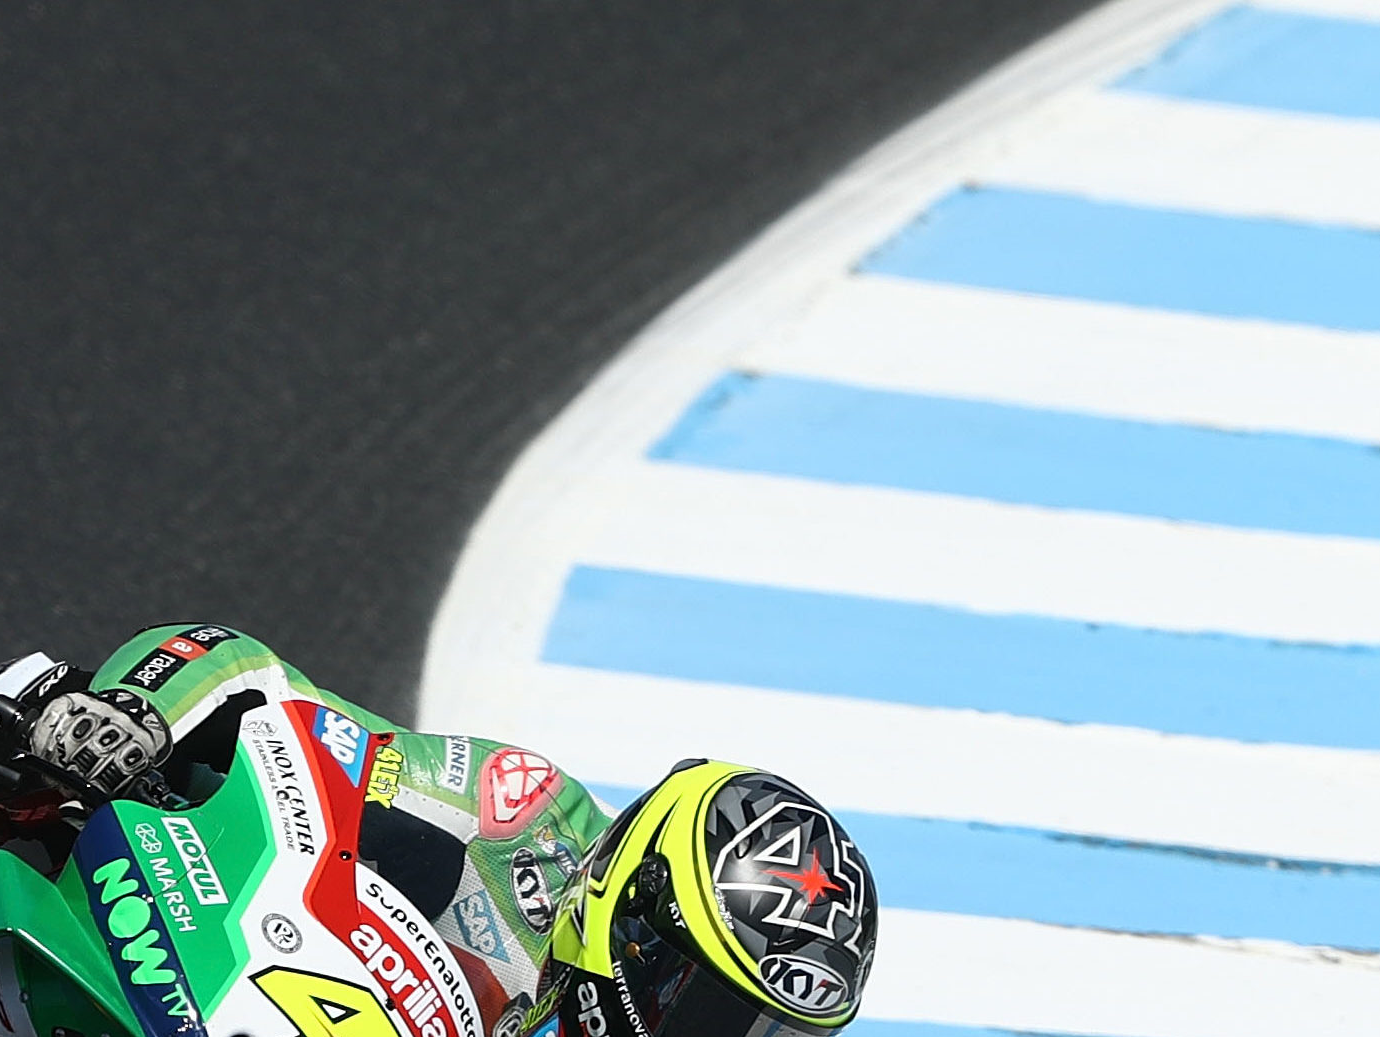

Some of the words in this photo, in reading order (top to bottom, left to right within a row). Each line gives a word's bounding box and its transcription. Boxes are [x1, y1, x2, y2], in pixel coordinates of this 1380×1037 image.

[134, 653, 177, 686] racer
[320, 710, 360, 765] SAP
[266, 739, 298, 782] INOX
[286, 784, 315, 856] CENTER
[149, 857, 197, 932] MARSH
[168, 821, 221, 905] MOTUL
[93, 857, 177, 985] NOW
[459, 891, 497, 955] SAP
